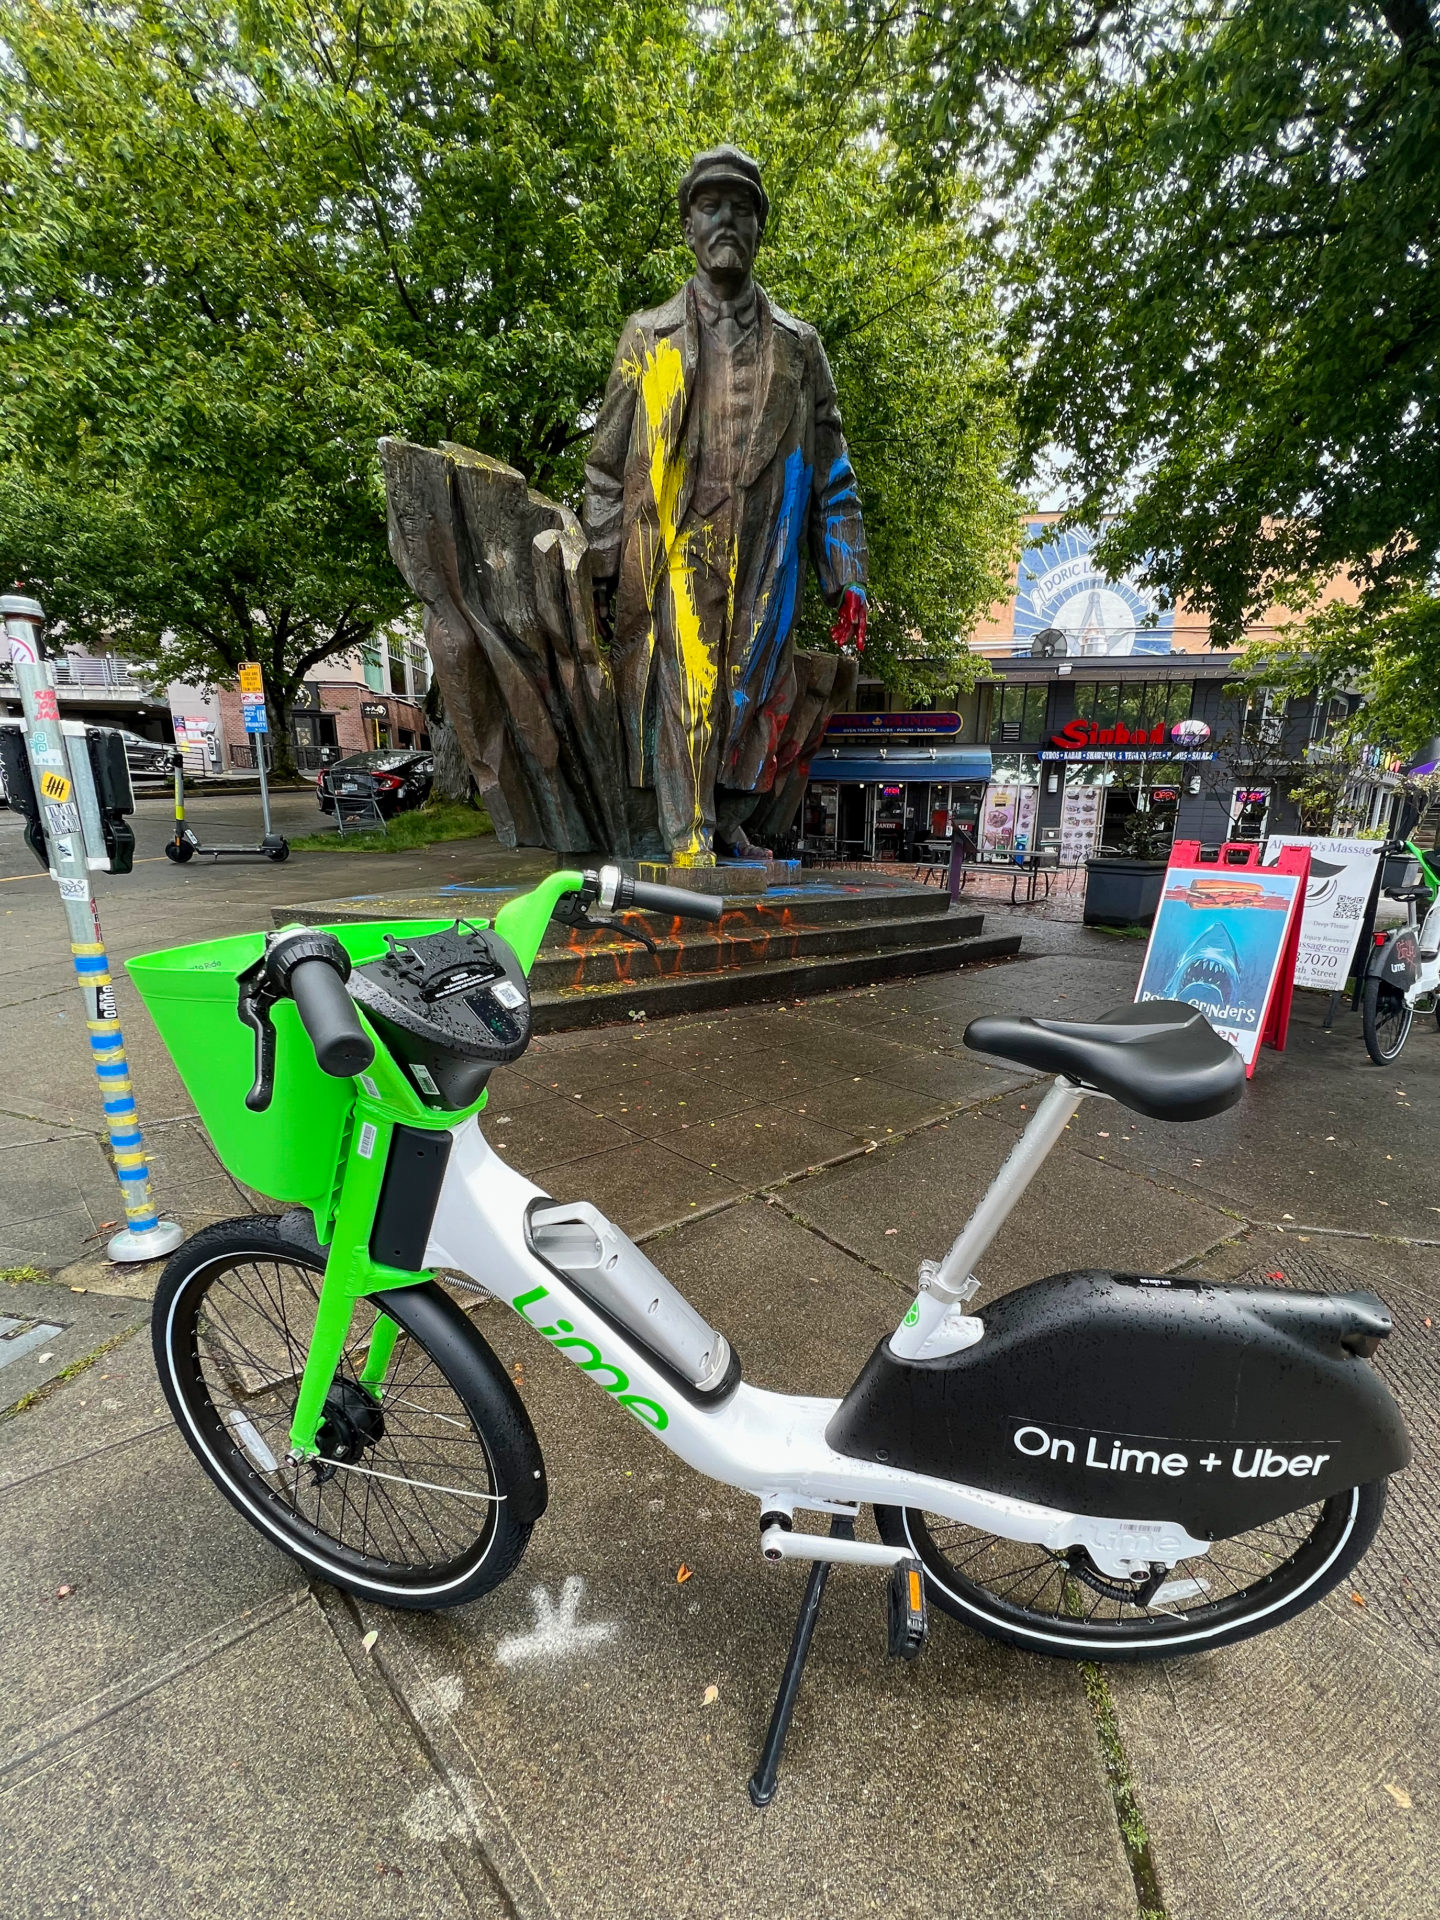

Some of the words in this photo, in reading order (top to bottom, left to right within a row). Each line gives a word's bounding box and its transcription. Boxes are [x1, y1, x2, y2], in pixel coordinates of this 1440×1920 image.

[1043, 563, 1080, 592] DORIC
[1050, 718, 1166, 749] Sinbad
[1041, 751, 1060, 760] GYROS
[1153, 791, 1177, 800] OPEN
[1329, 841, 1374, 856] Massag
[1310, 967, 1337, 978] Street
[512, 1285, 669, 1431] Lime
[1013, 1426, 1076, 1463] On
[1085, 1437, 1189, 1477] Lime
[1199, 1452, 1222, 1473] +
[1231, 1448, 1330, 1478] Uber
